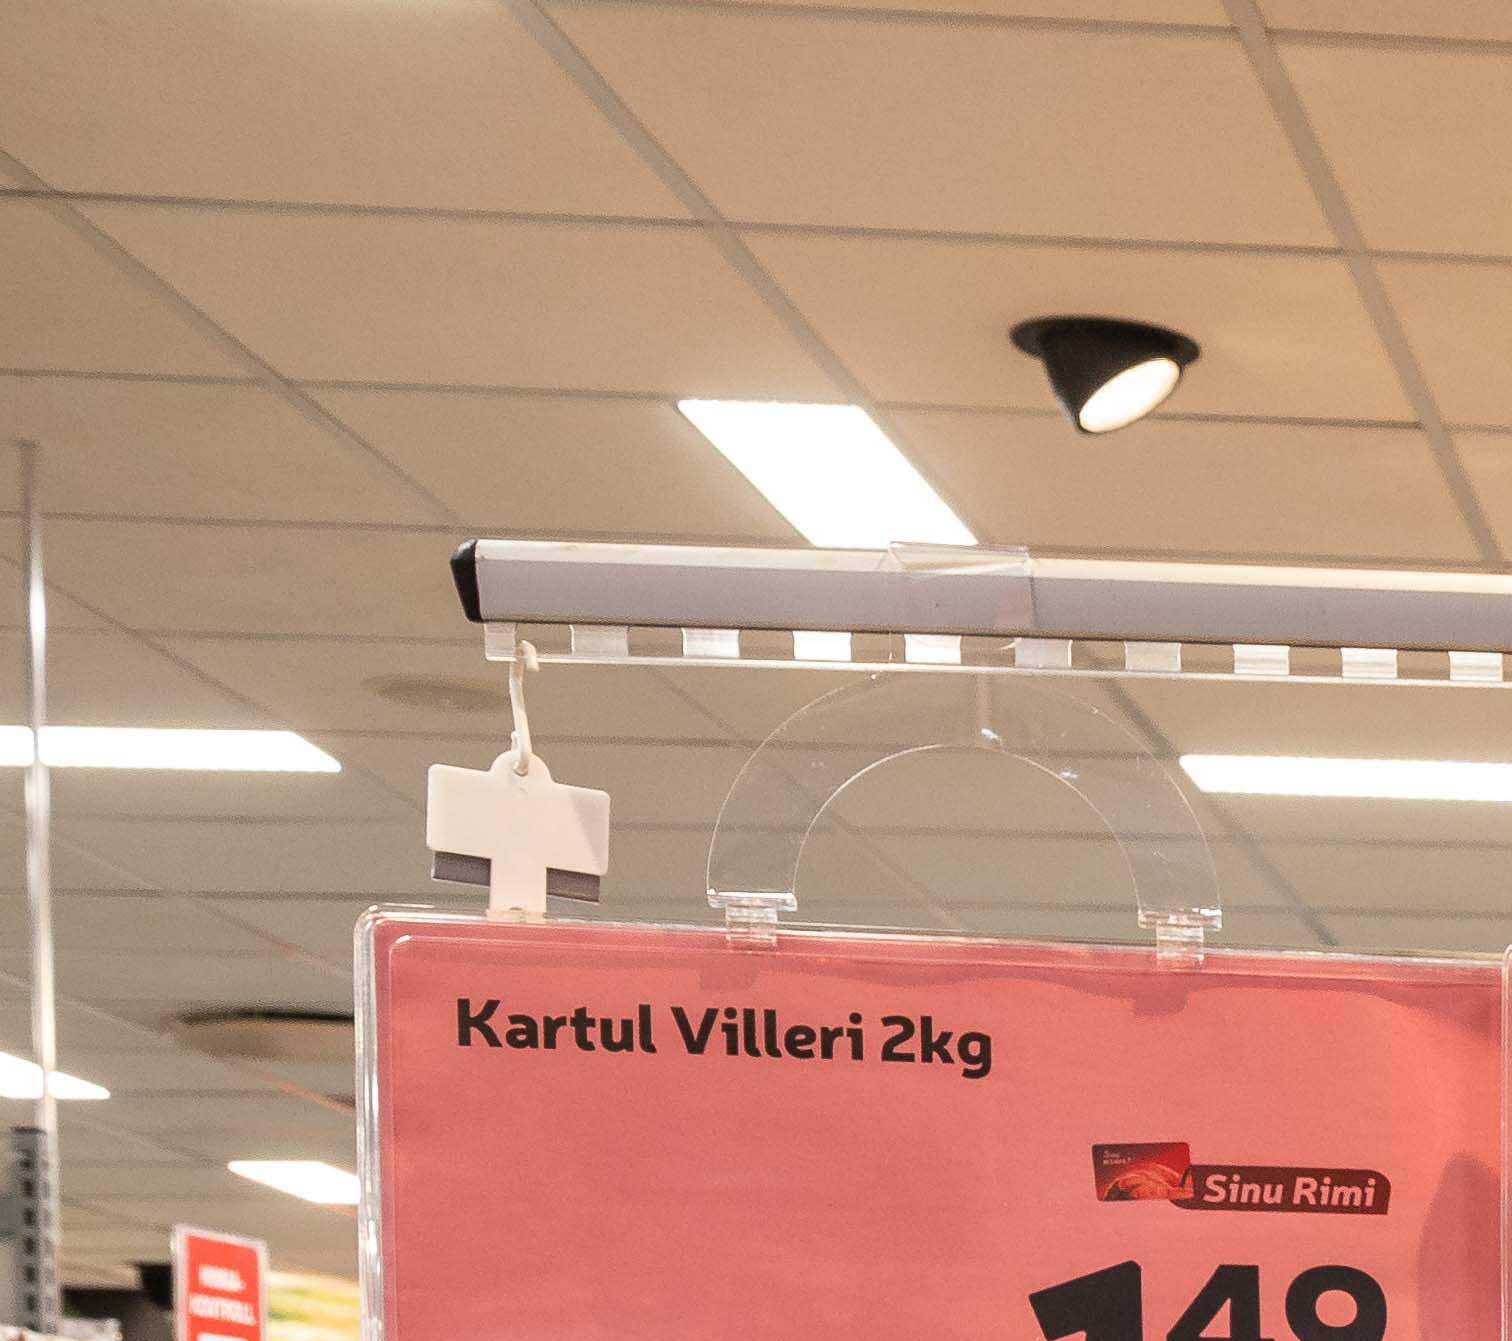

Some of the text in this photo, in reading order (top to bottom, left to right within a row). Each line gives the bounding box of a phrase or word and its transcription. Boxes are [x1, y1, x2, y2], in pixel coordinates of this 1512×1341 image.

[456, 998, 992, 1080] Kartul Villeri 2kg
[1202, 1173, 1376, 1207] Sinu Rimi
